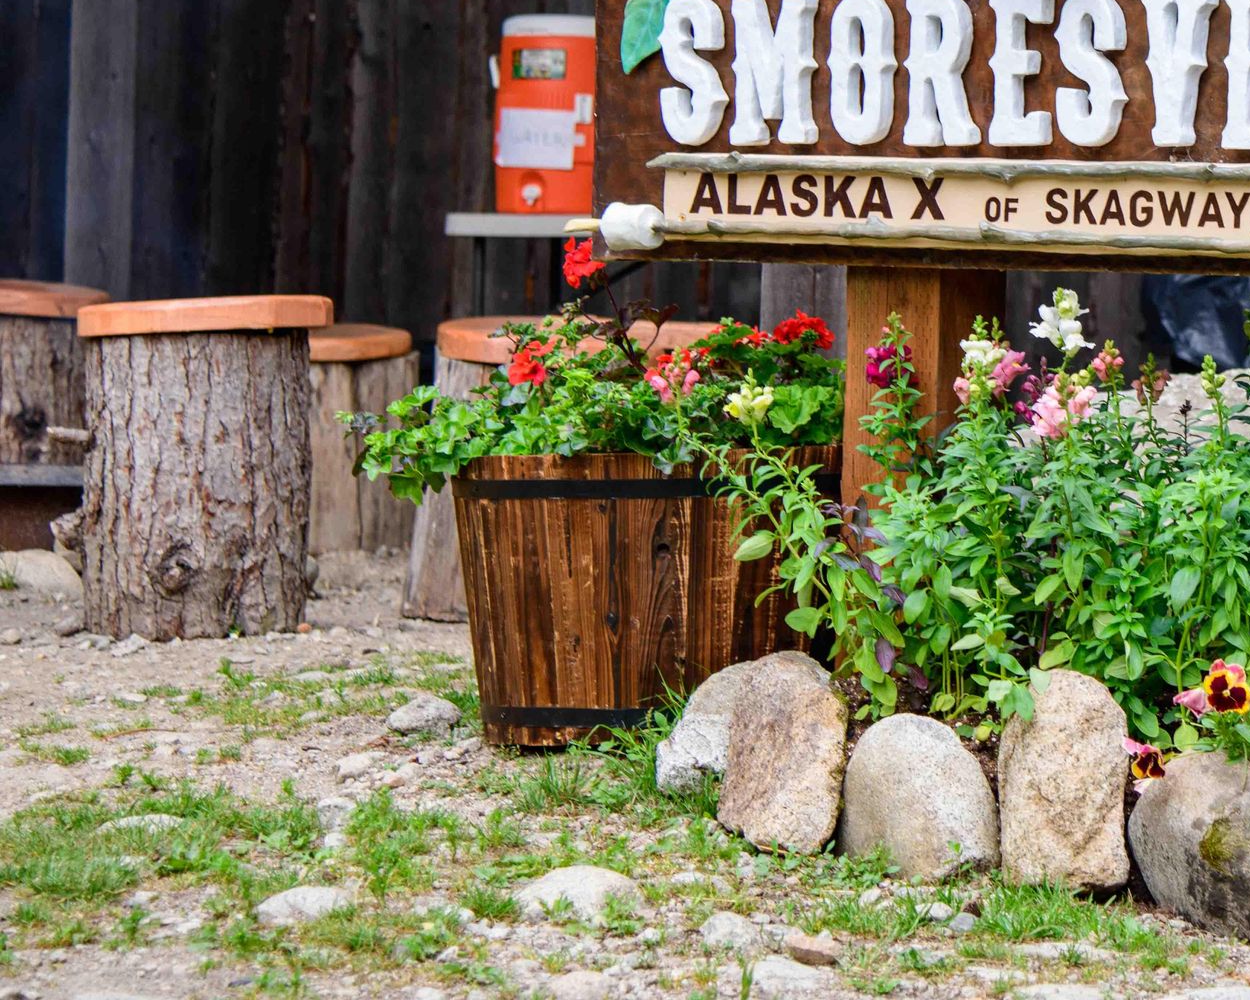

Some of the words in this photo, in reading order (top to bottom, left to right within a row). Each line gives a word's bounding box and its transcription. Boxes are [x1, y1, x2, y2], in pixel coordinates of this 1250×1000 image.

[690, 173, 893, 220] ALASKA
[911, 177, 945, 220] X
[985, 197, 1019, 223] OF
